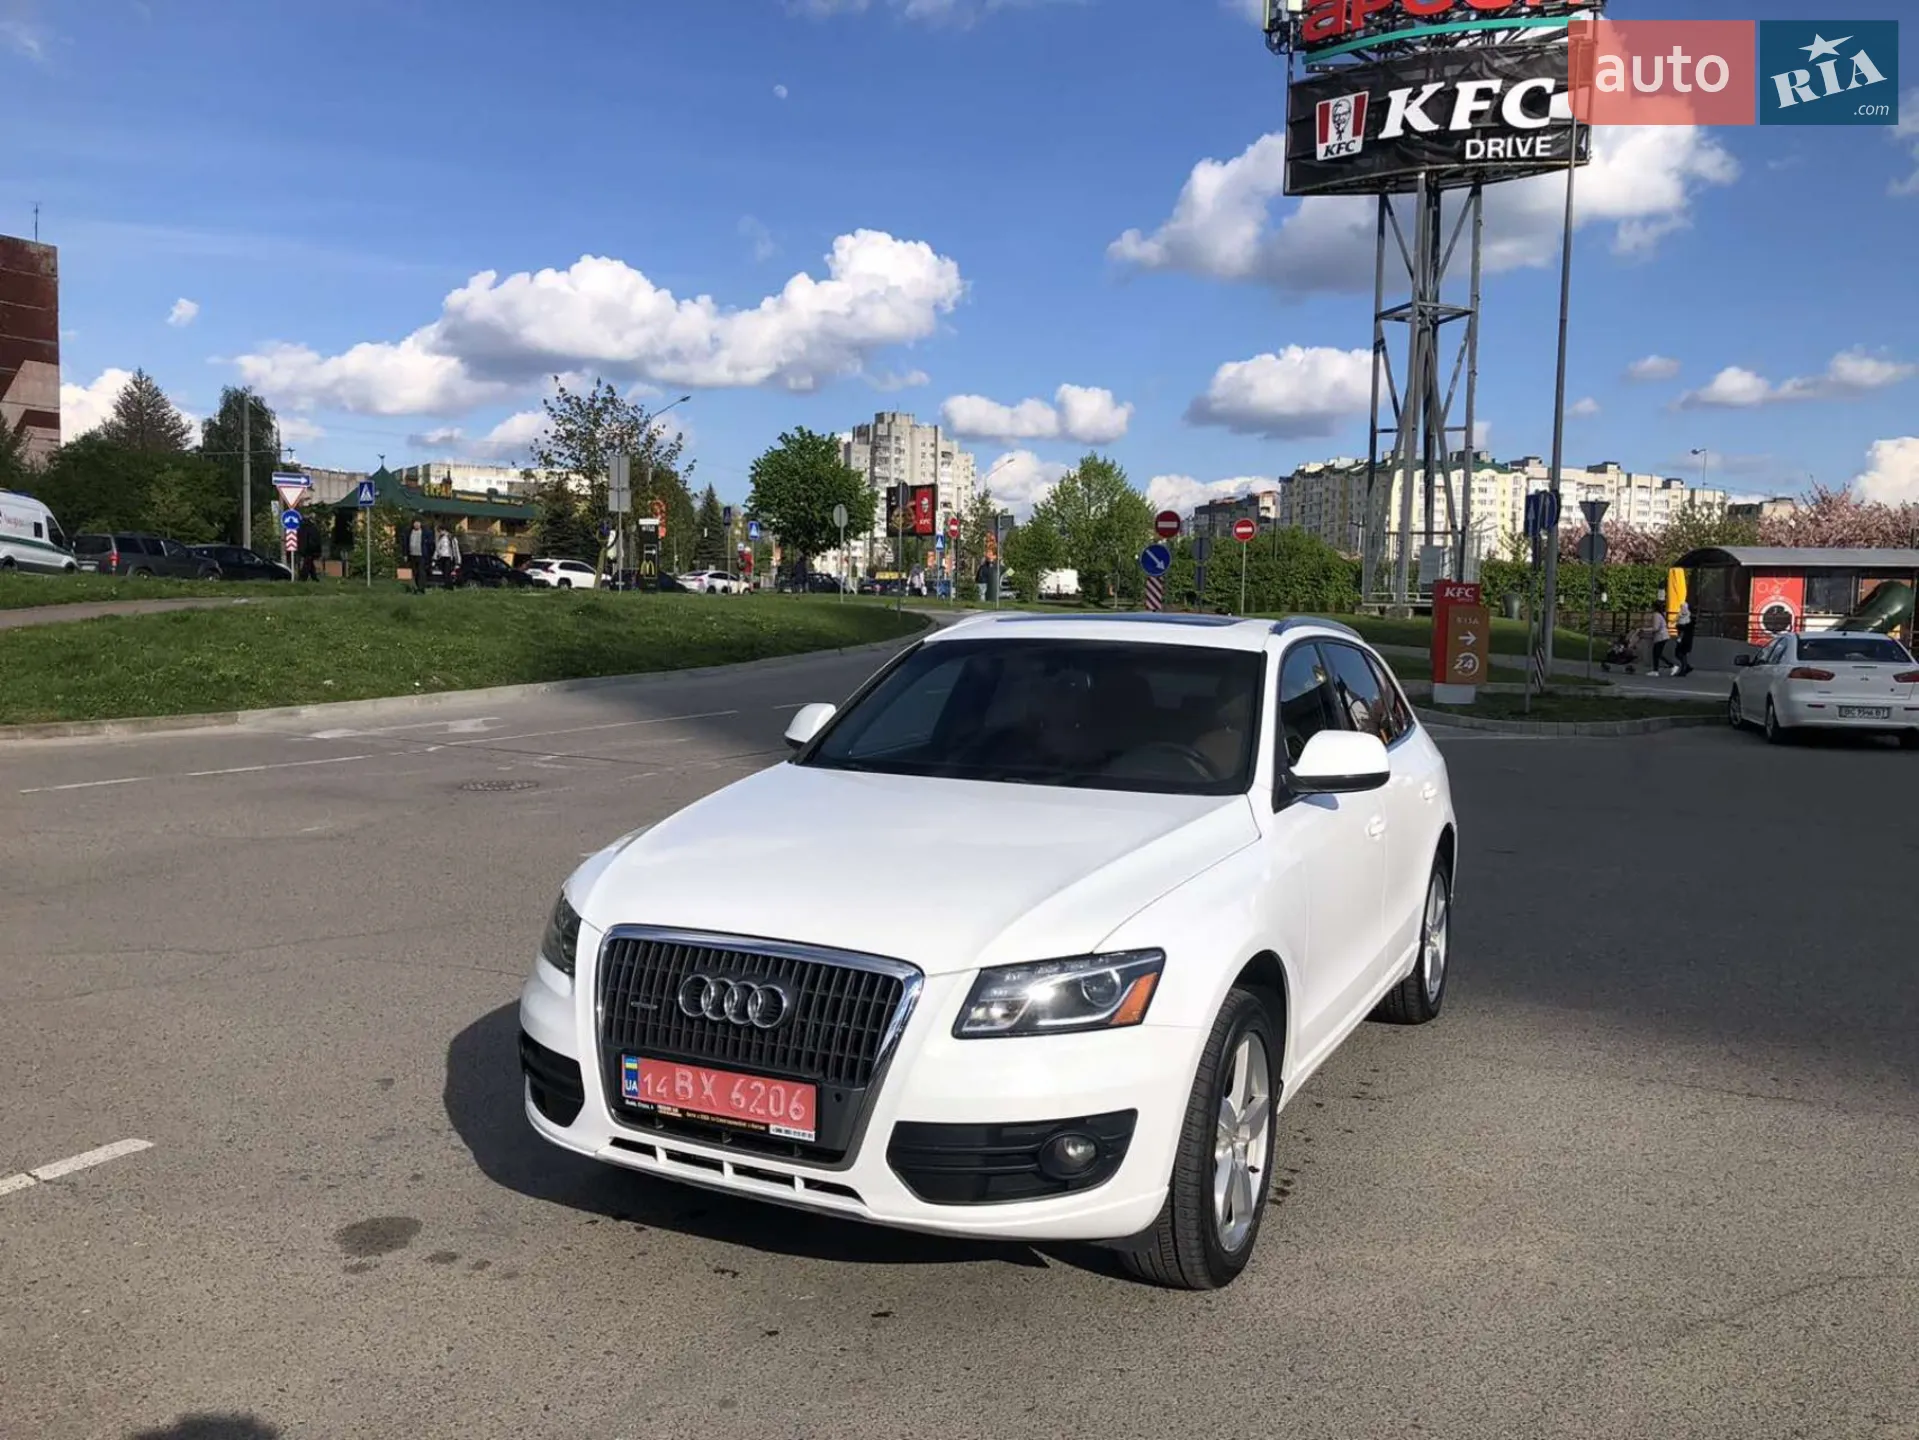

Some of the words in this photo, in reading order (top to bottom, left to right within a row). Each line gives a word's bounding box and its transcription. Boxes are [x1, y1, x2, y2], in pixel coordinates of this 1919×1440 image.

[1378, 77, 1556, 140] KFC
[1324, 139, 1356, 158] KFC
[1465, 136, 1552, 160] DRIVE
[1444, 587, 1475, 598] KFC
[625, 1080, 638, 1092] UA
[730, 1080, 806, 1121] 6206
